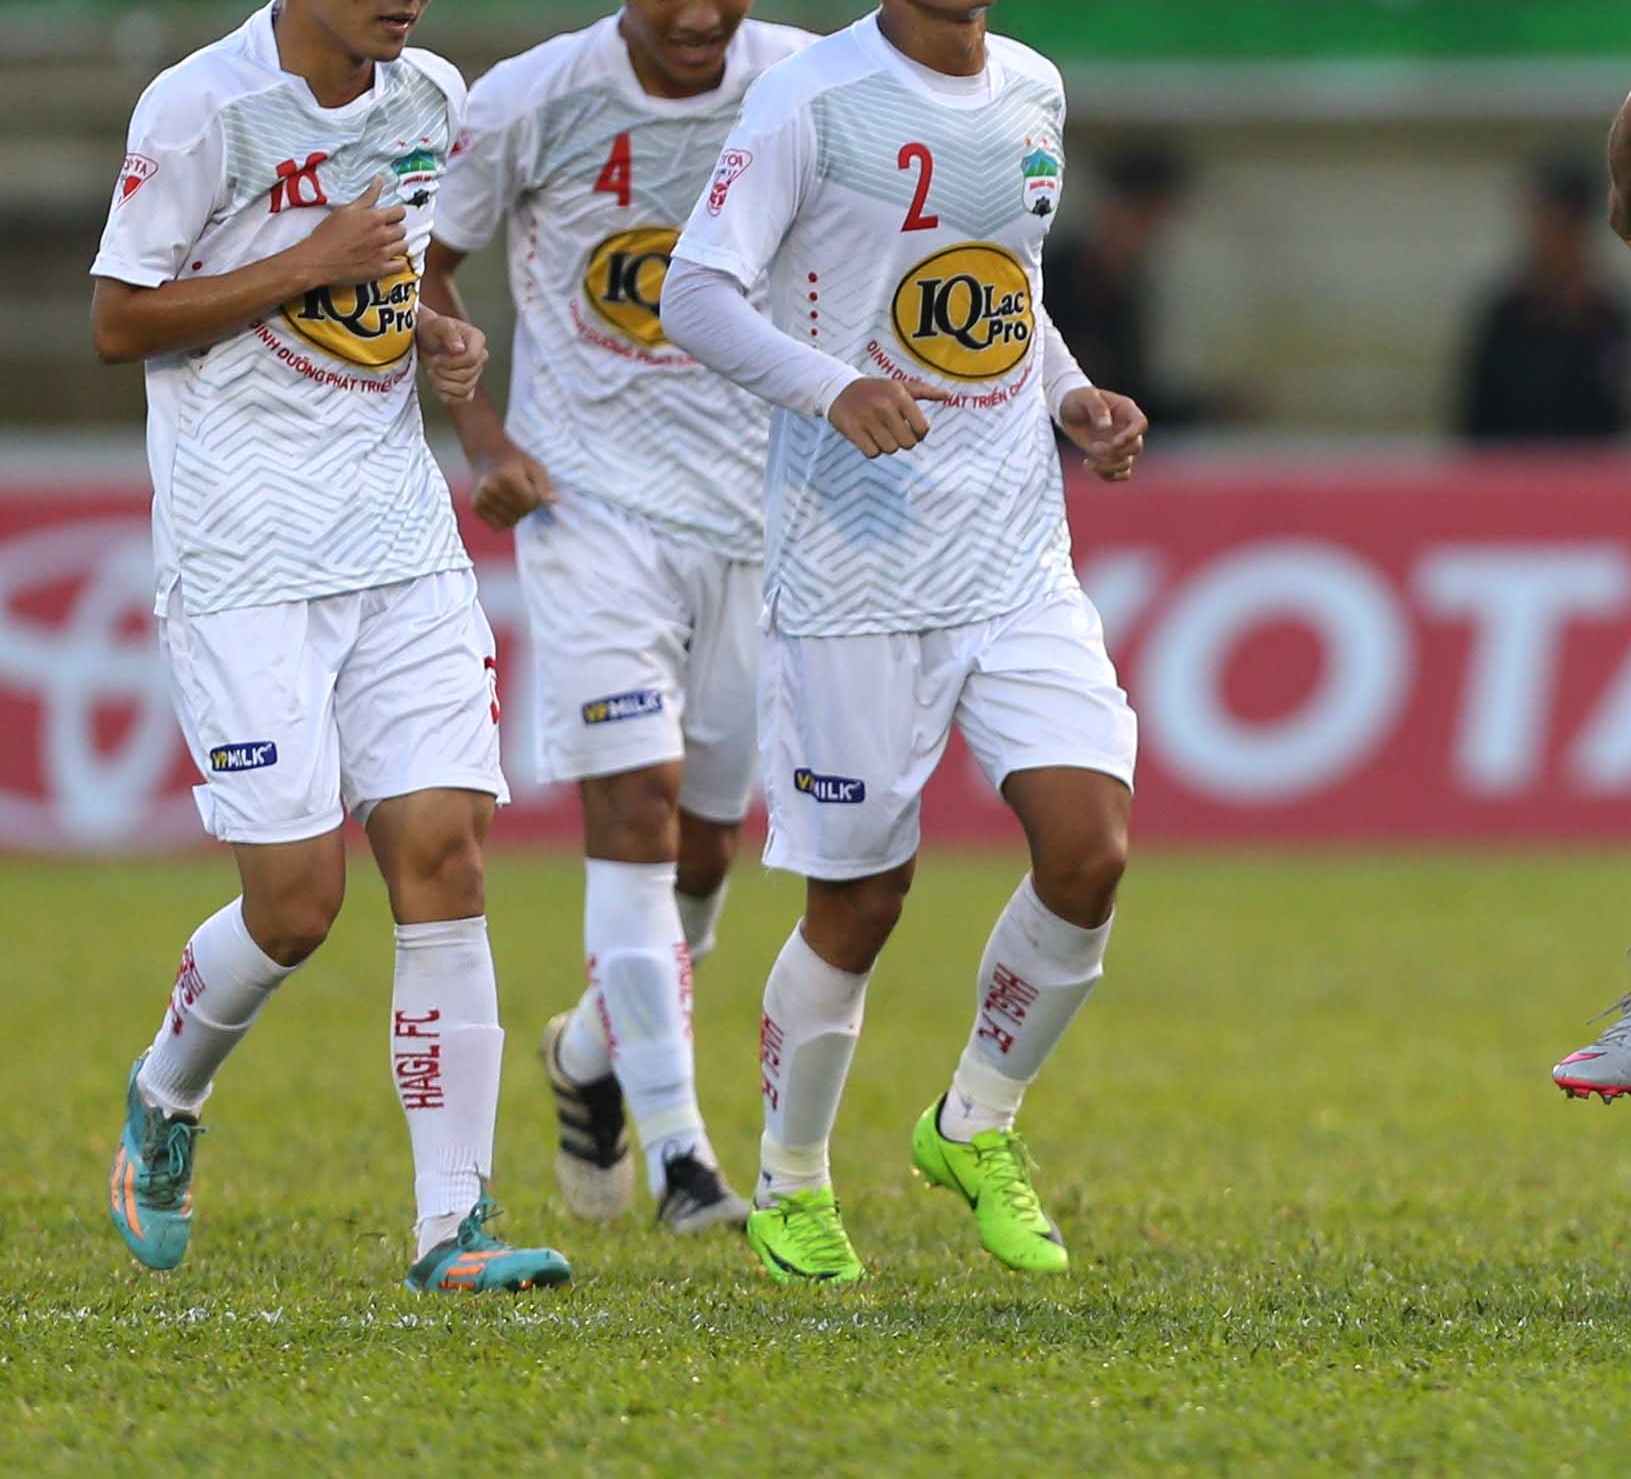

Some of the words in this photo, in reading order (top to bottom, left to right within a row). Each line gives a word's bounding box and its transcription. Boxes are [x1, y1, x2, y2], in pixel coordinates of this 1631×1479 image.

[593, 132, 631, 208] 4
[898, 141, 939, 232] 2
[380, 307, 414, 335] Pro
[912, 275, 990, 350] IQ
[983, 285, 1025, 318] Lac
[988, 319, 1028, 344] Pro
[212, 743, 272, 769] VPMILK
[394, 1009, 441, 1037] FC
[394, 1044, 445, 1109] HAGL
